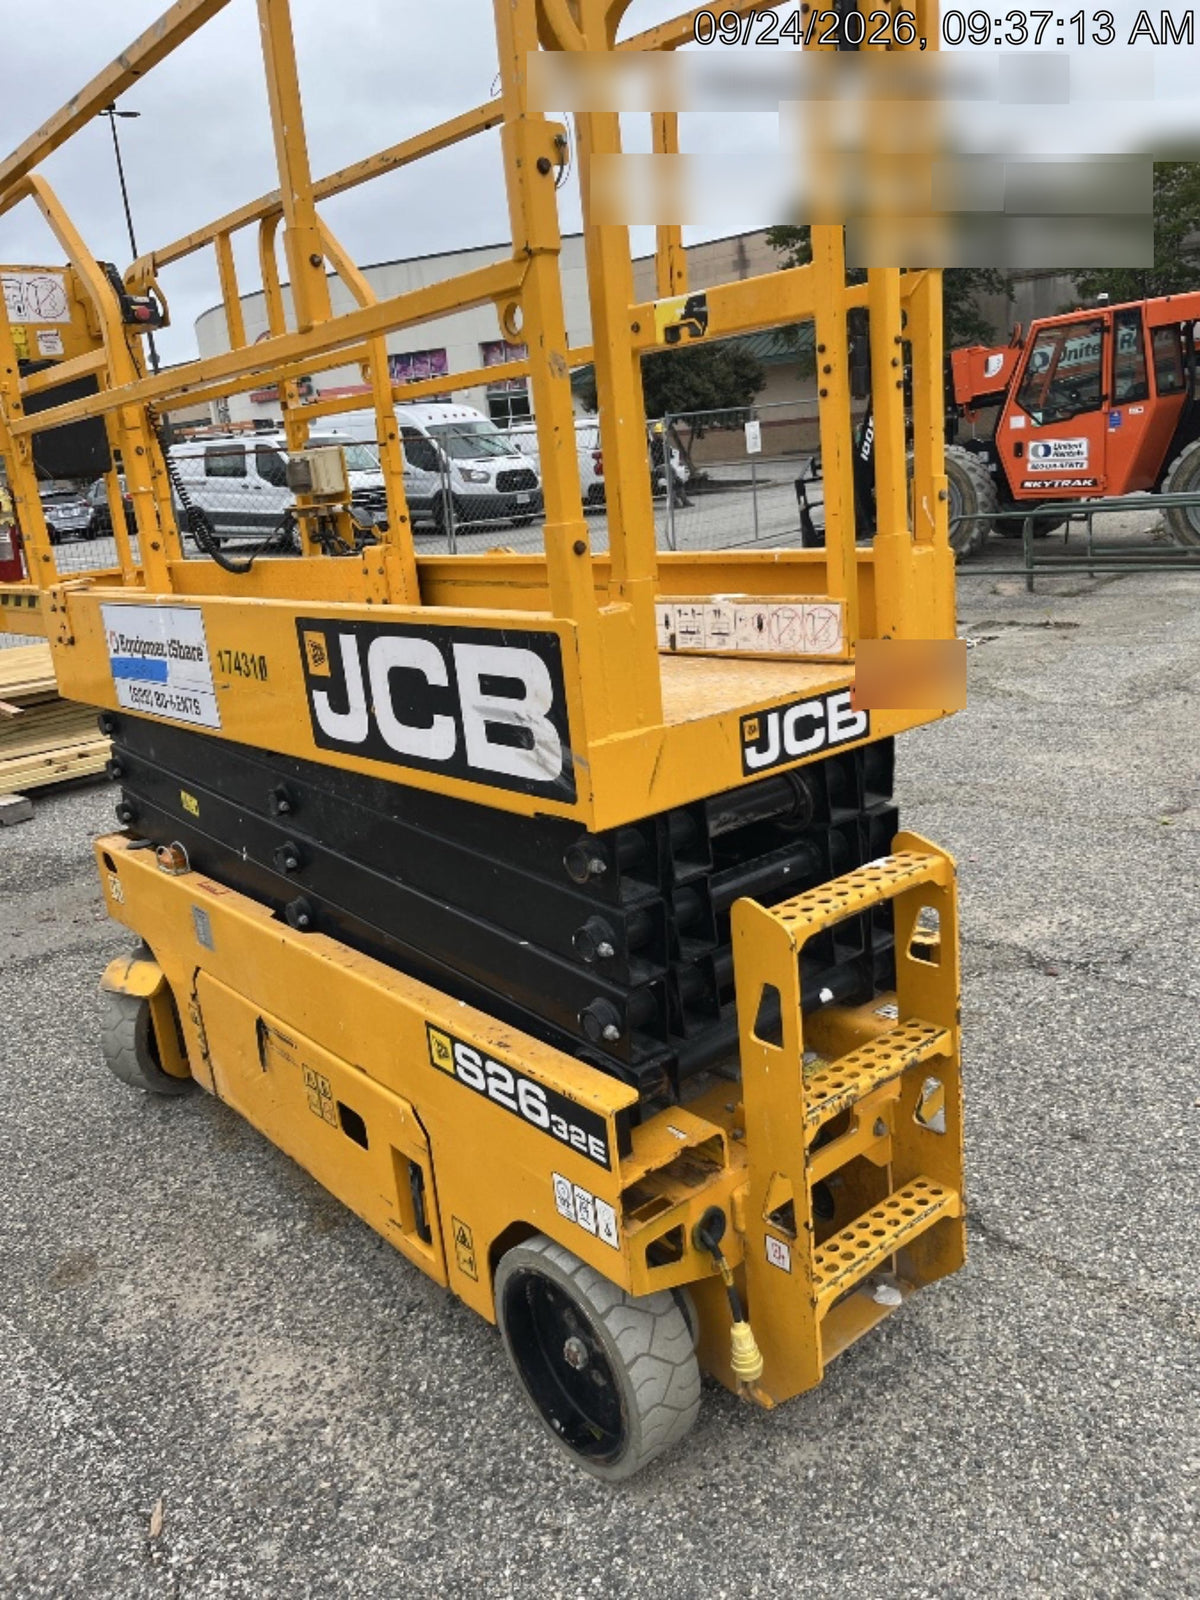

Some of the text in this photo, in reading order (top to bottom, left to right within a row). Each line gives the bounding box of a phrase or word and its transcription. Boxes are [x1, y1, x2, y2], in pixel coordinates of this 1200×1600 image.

[1023, 479, 1093, 488] SKYTRAK
[312, 633, 563, 782] JCB
[744, 690, 867, 769] JCB
[453, 1042, 608, 1164] S26 32E
